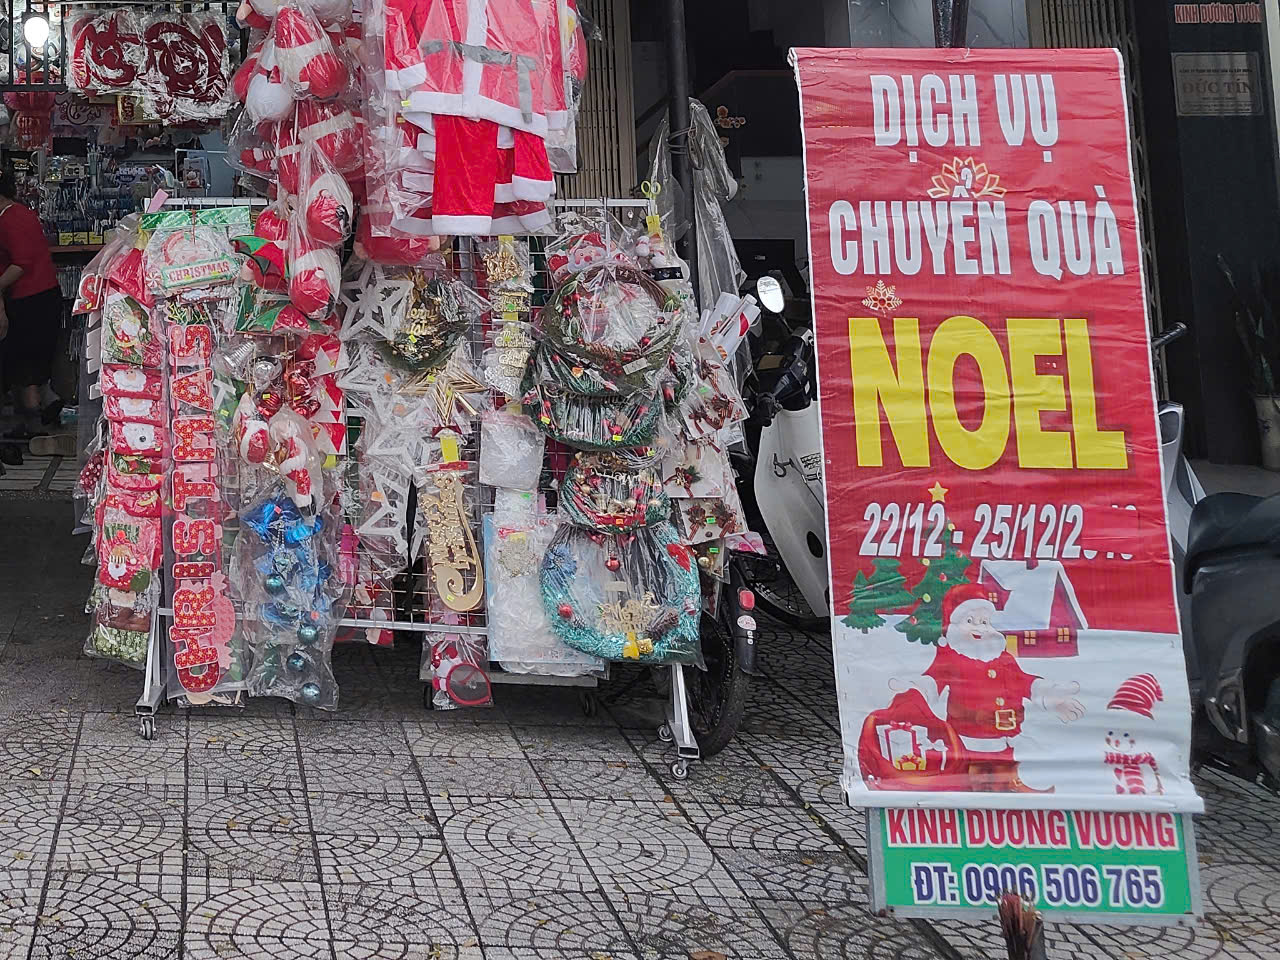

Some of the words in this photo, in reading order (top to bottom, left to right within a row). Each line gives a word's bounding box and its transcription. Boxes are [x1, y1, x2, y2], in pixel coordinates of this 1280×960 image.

[1174, 4, 1200, 24] KINH
[1235, 2, 1263, 24] VƯƠN
[870, 73, 982, 163] DỊCH
[994, 74, 1060, 163] VỤ
[828, 166, 1012, 276] CHUYỂN
[1027, 184, 1125, 282] QUÀ
[168, 260, 231, 282] CHRISTMAS
[848, 315, 1129, 470] NOEL
[169, 324, 221, 694] CHRISTMAS
[859, 502, 946, 557] 22/12
[887, 808, 961, 848] KINH
[913, 864, 959, 905] ĐT:
[963, 864, 1037, 906] 0906
[1042, 865, 1101, 907] 506
[1103, 865, 1164, 908] 765
